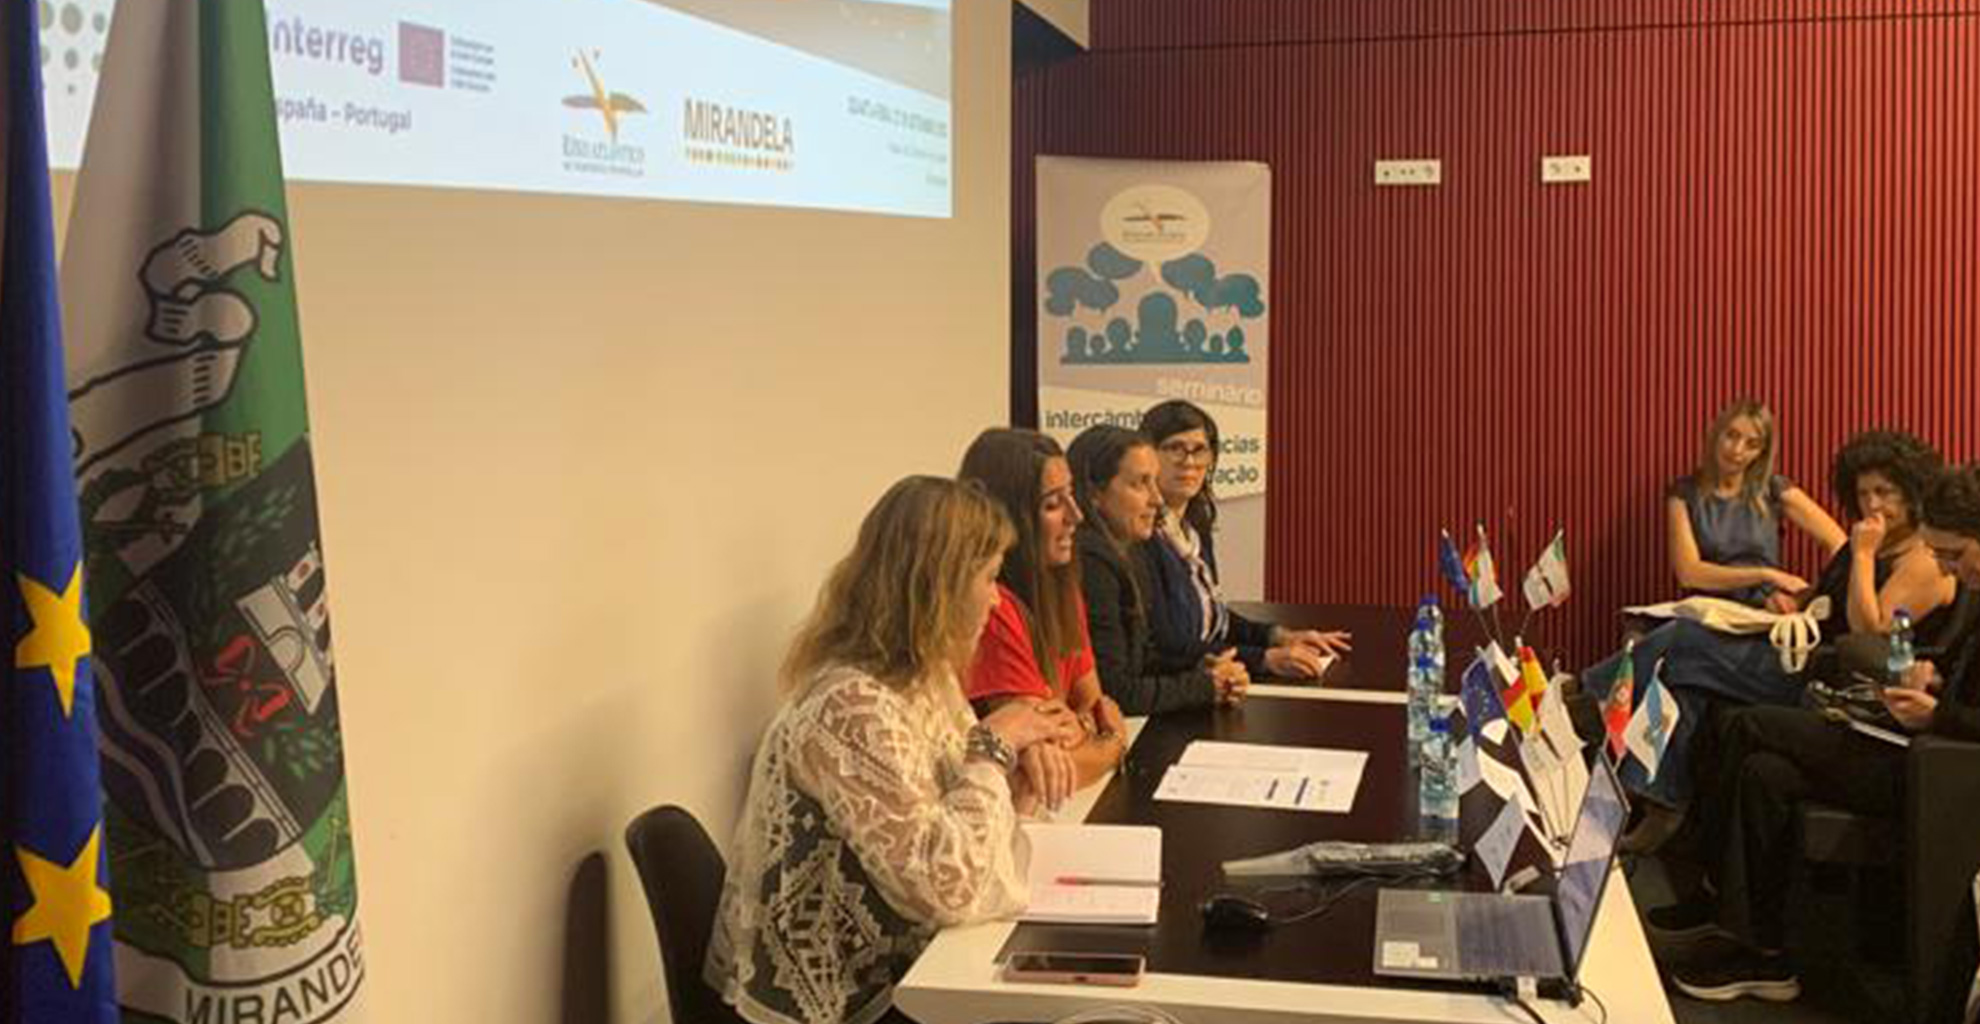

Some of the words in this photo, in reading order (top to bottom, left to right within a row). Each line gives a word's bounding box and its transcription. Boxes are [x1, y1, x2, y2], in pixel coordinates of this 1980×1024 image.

[272, 15, 385, 76] nterreg
[277, 96, 327, 124] spaña
[344, 101, 411, 134] Portugal
[683, 96, 795, 154] MIRANDELA
[185, 926, 361, 1024] MIRANDE
